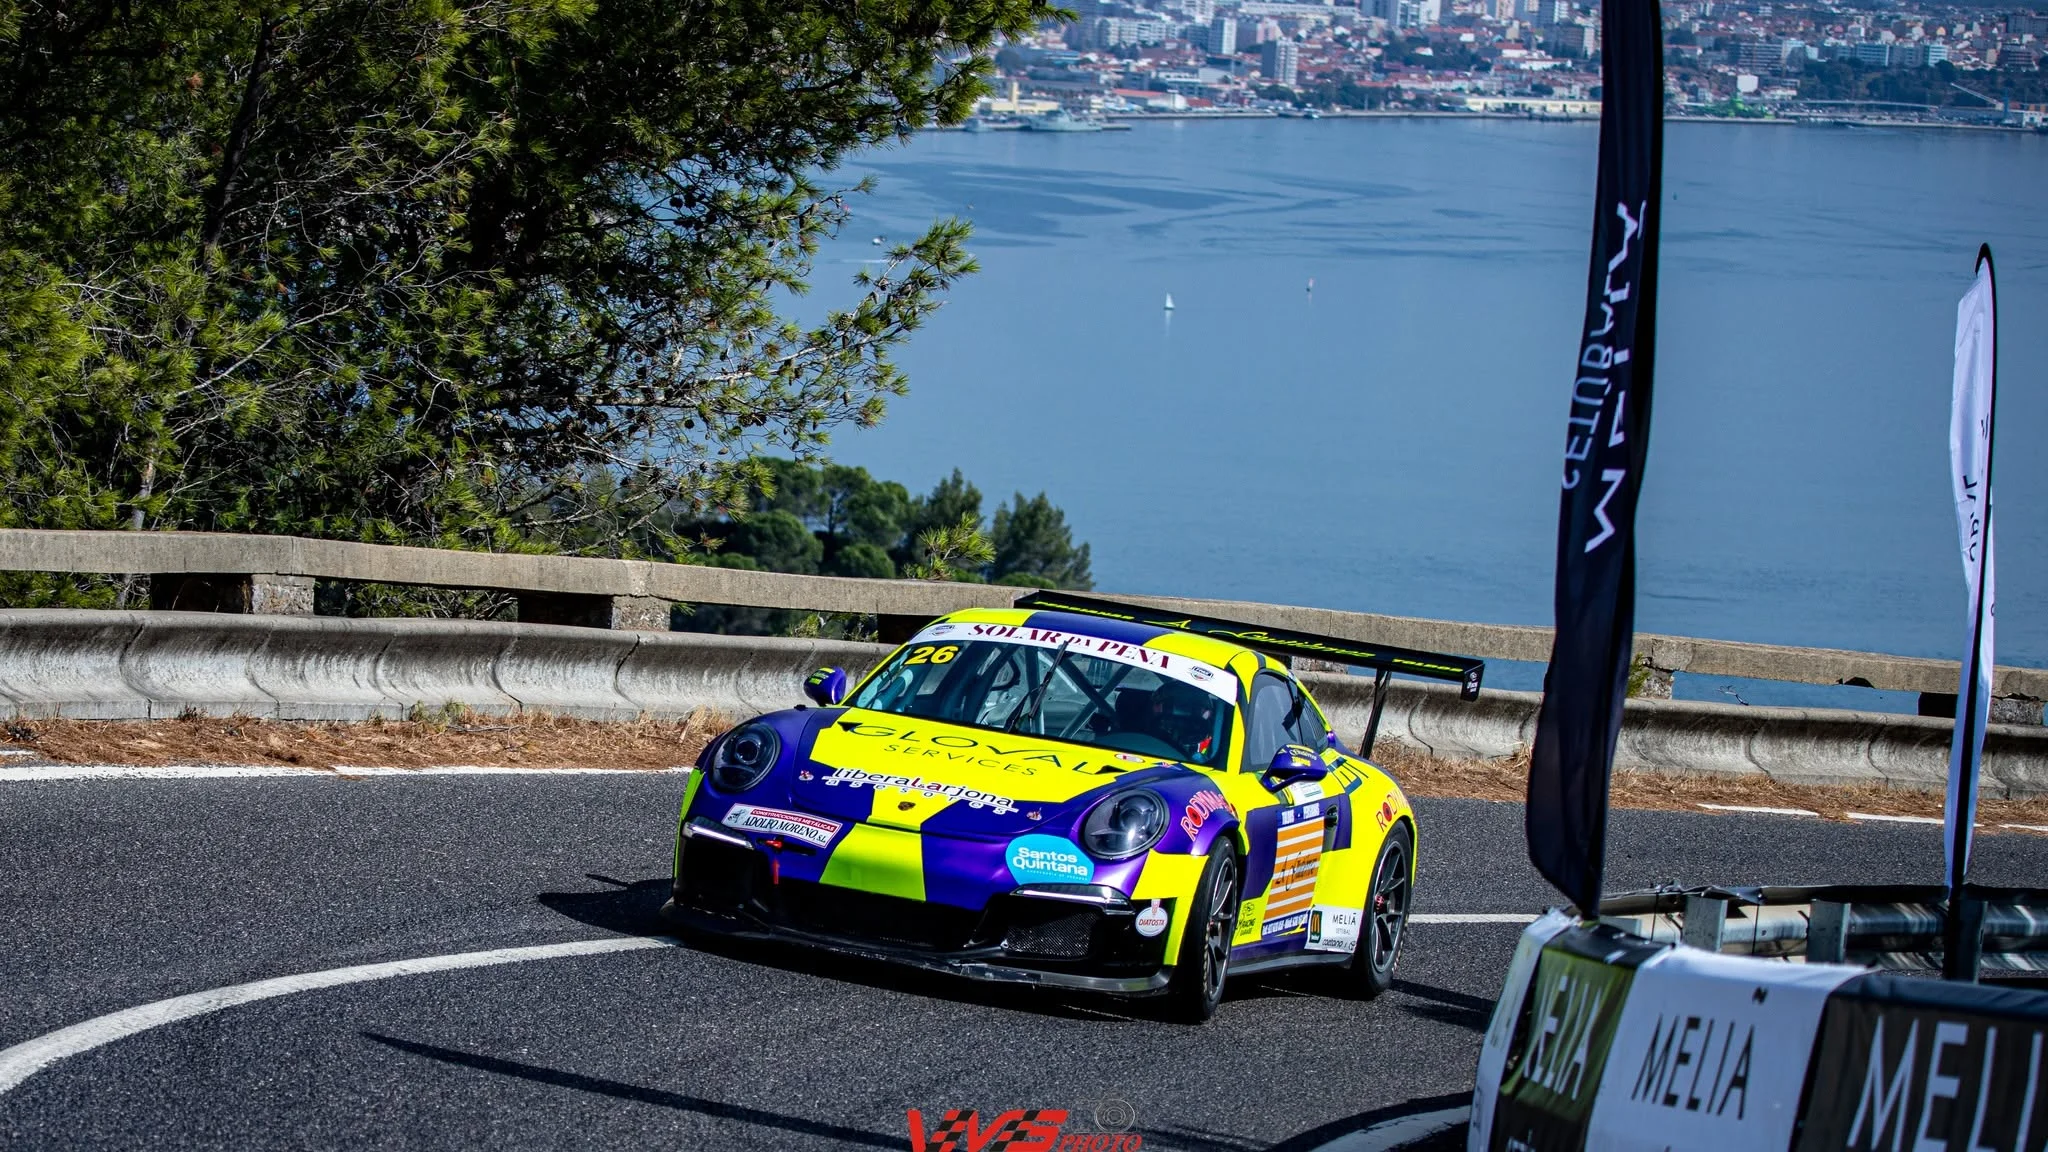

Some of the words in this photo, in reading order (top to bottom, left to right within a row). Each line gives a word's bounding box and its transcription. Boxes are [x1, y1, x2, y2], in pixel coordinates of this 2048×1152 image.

[904, 645, 958, 665] 26
[967, 622, 1060, 644] SOLAR
[1096, 640, 1170, 670] PENA
[851, 725, 1104, 776] GLOVAL
[884, 744, 1038, 777] SERVICES
[743, 816, 779, 829] ADOLFO
[1012, 856, 1088, 876] Quintana
[1018, 847, 1078, 863] Santos
[1846, 1013, 2048, 1152] MELI
